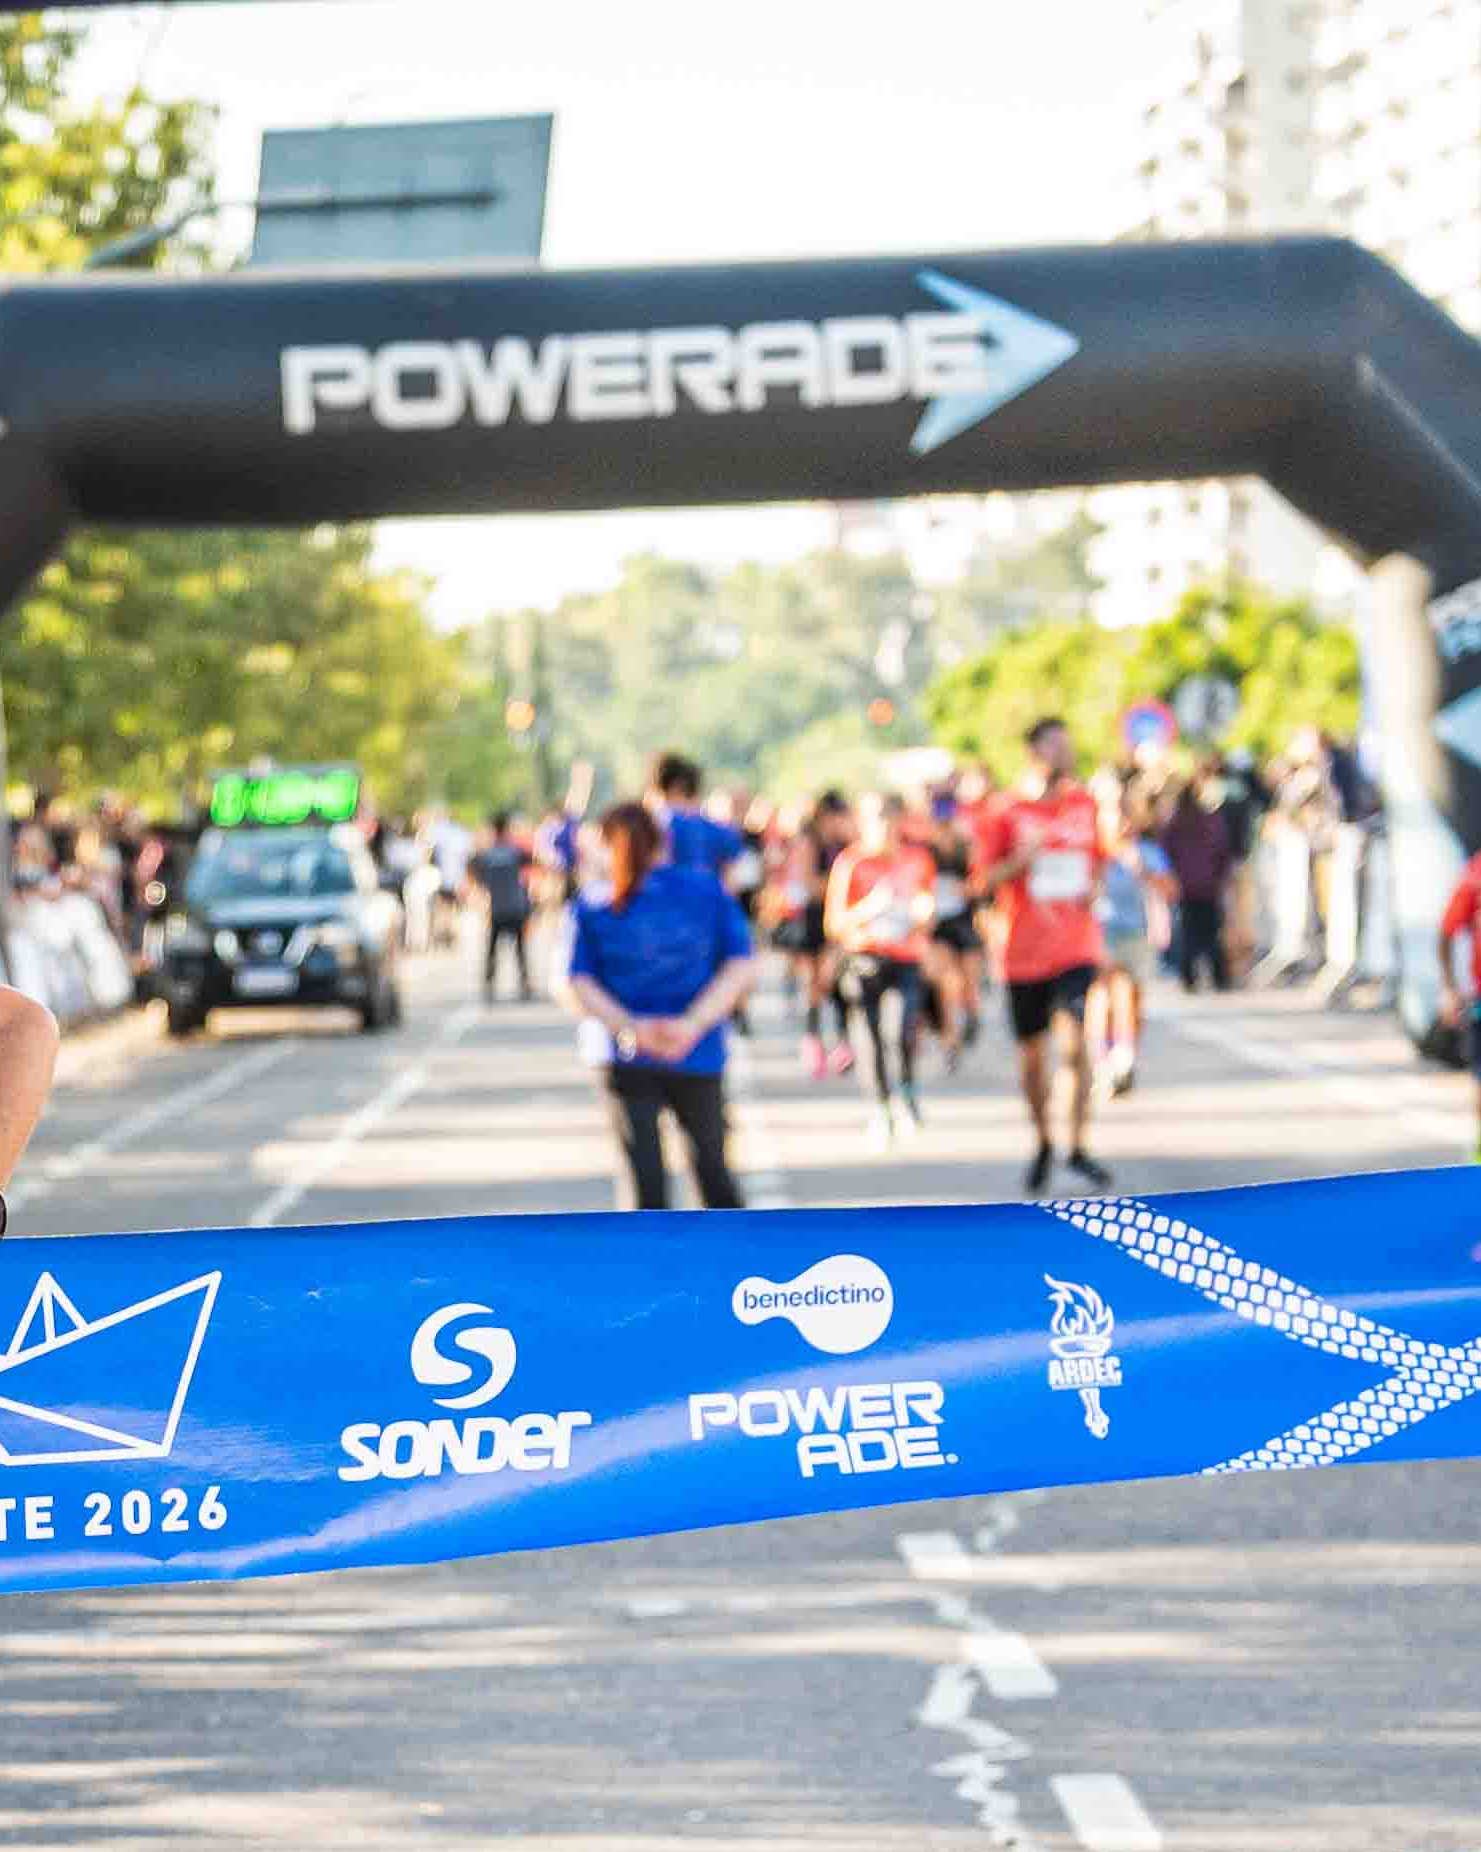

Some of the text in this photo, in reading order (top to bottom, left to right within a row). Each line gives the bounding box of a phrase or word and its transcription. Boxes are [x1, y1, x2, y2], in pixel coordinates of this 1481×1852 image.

[280, 312, 991, 435] POWERADE
[742, 1282, 885, 1310] benedictino
[1047, 1355, 1124, 1388] ARDEC
[688, 1380, 946, 1441] POWER
[82, 1485, 229, 1537] 2026
